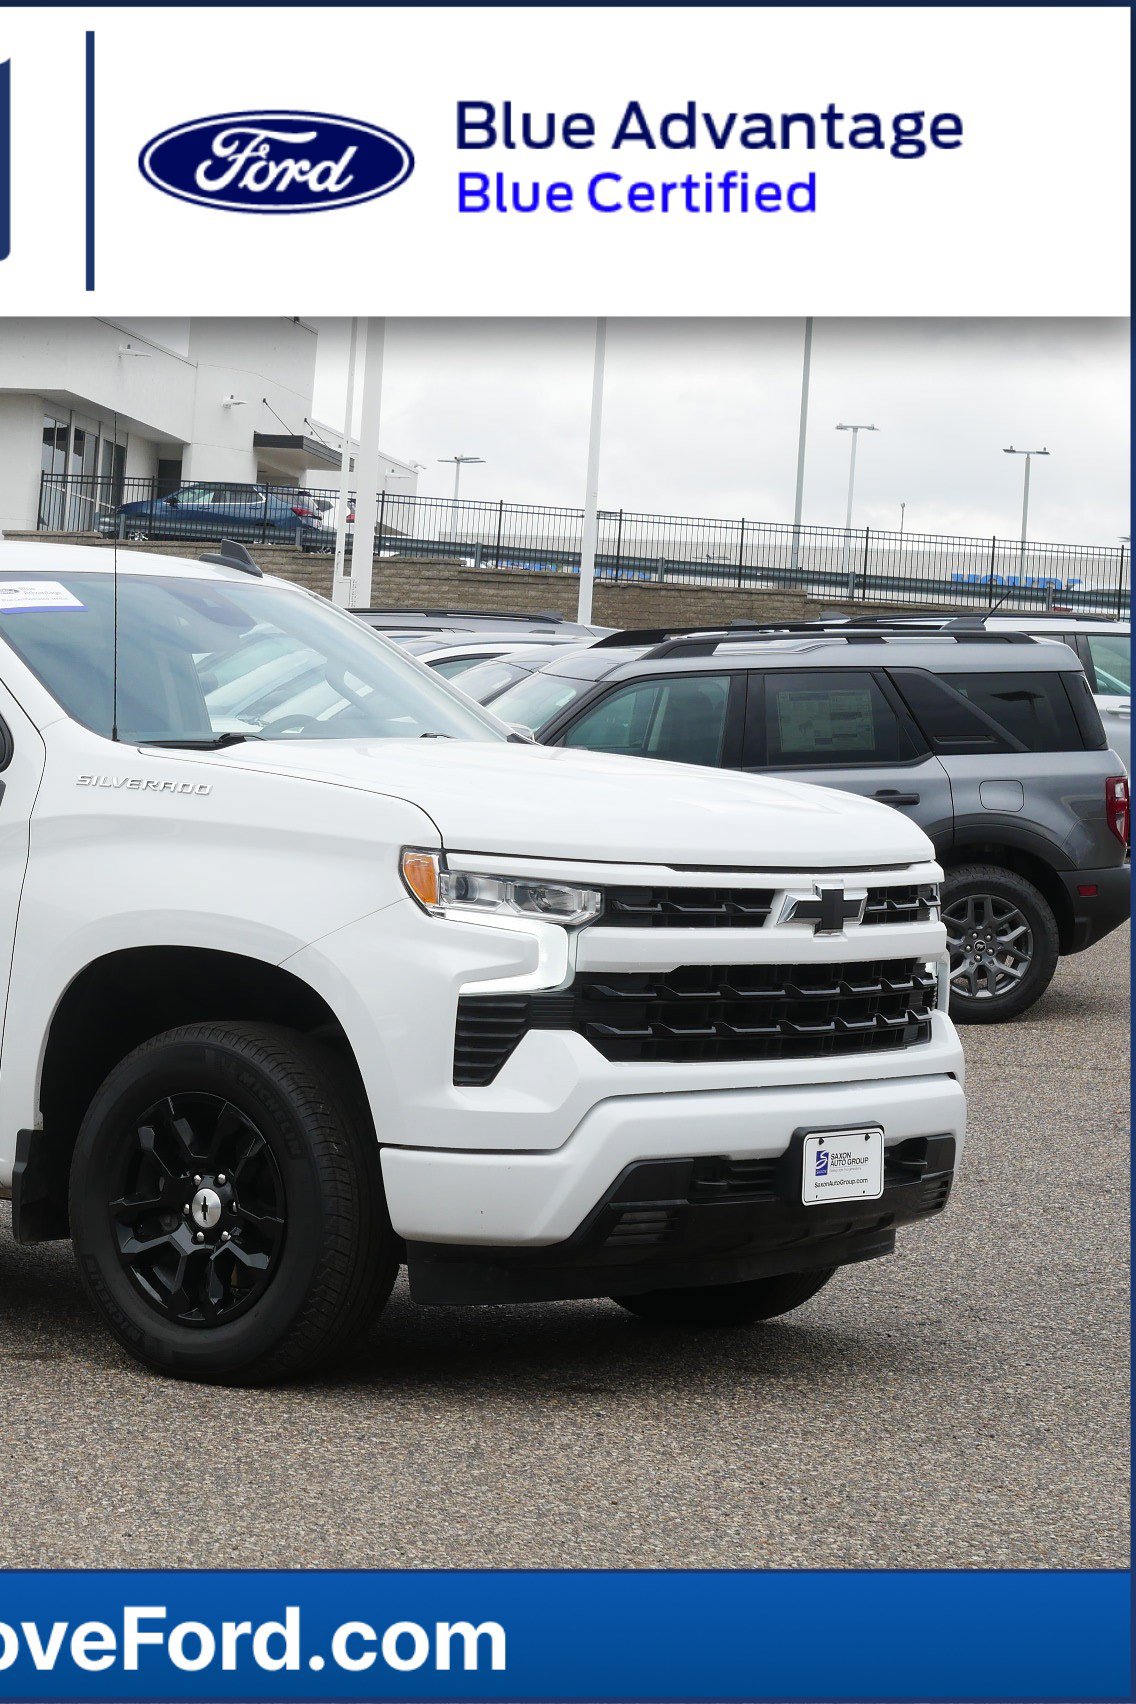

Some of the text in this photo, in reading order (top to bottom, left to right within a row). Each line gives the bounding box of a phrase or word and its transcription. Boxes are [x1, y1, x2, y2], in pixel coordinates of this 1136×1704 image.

[75, 774, 214, 796] SILVERADO
[830, 1152, 852, 1160] SAXON
[847, 1156, 869, 1166] GROUP
[814, 1178, 869, 1188] SaxonAutoGroup.com
